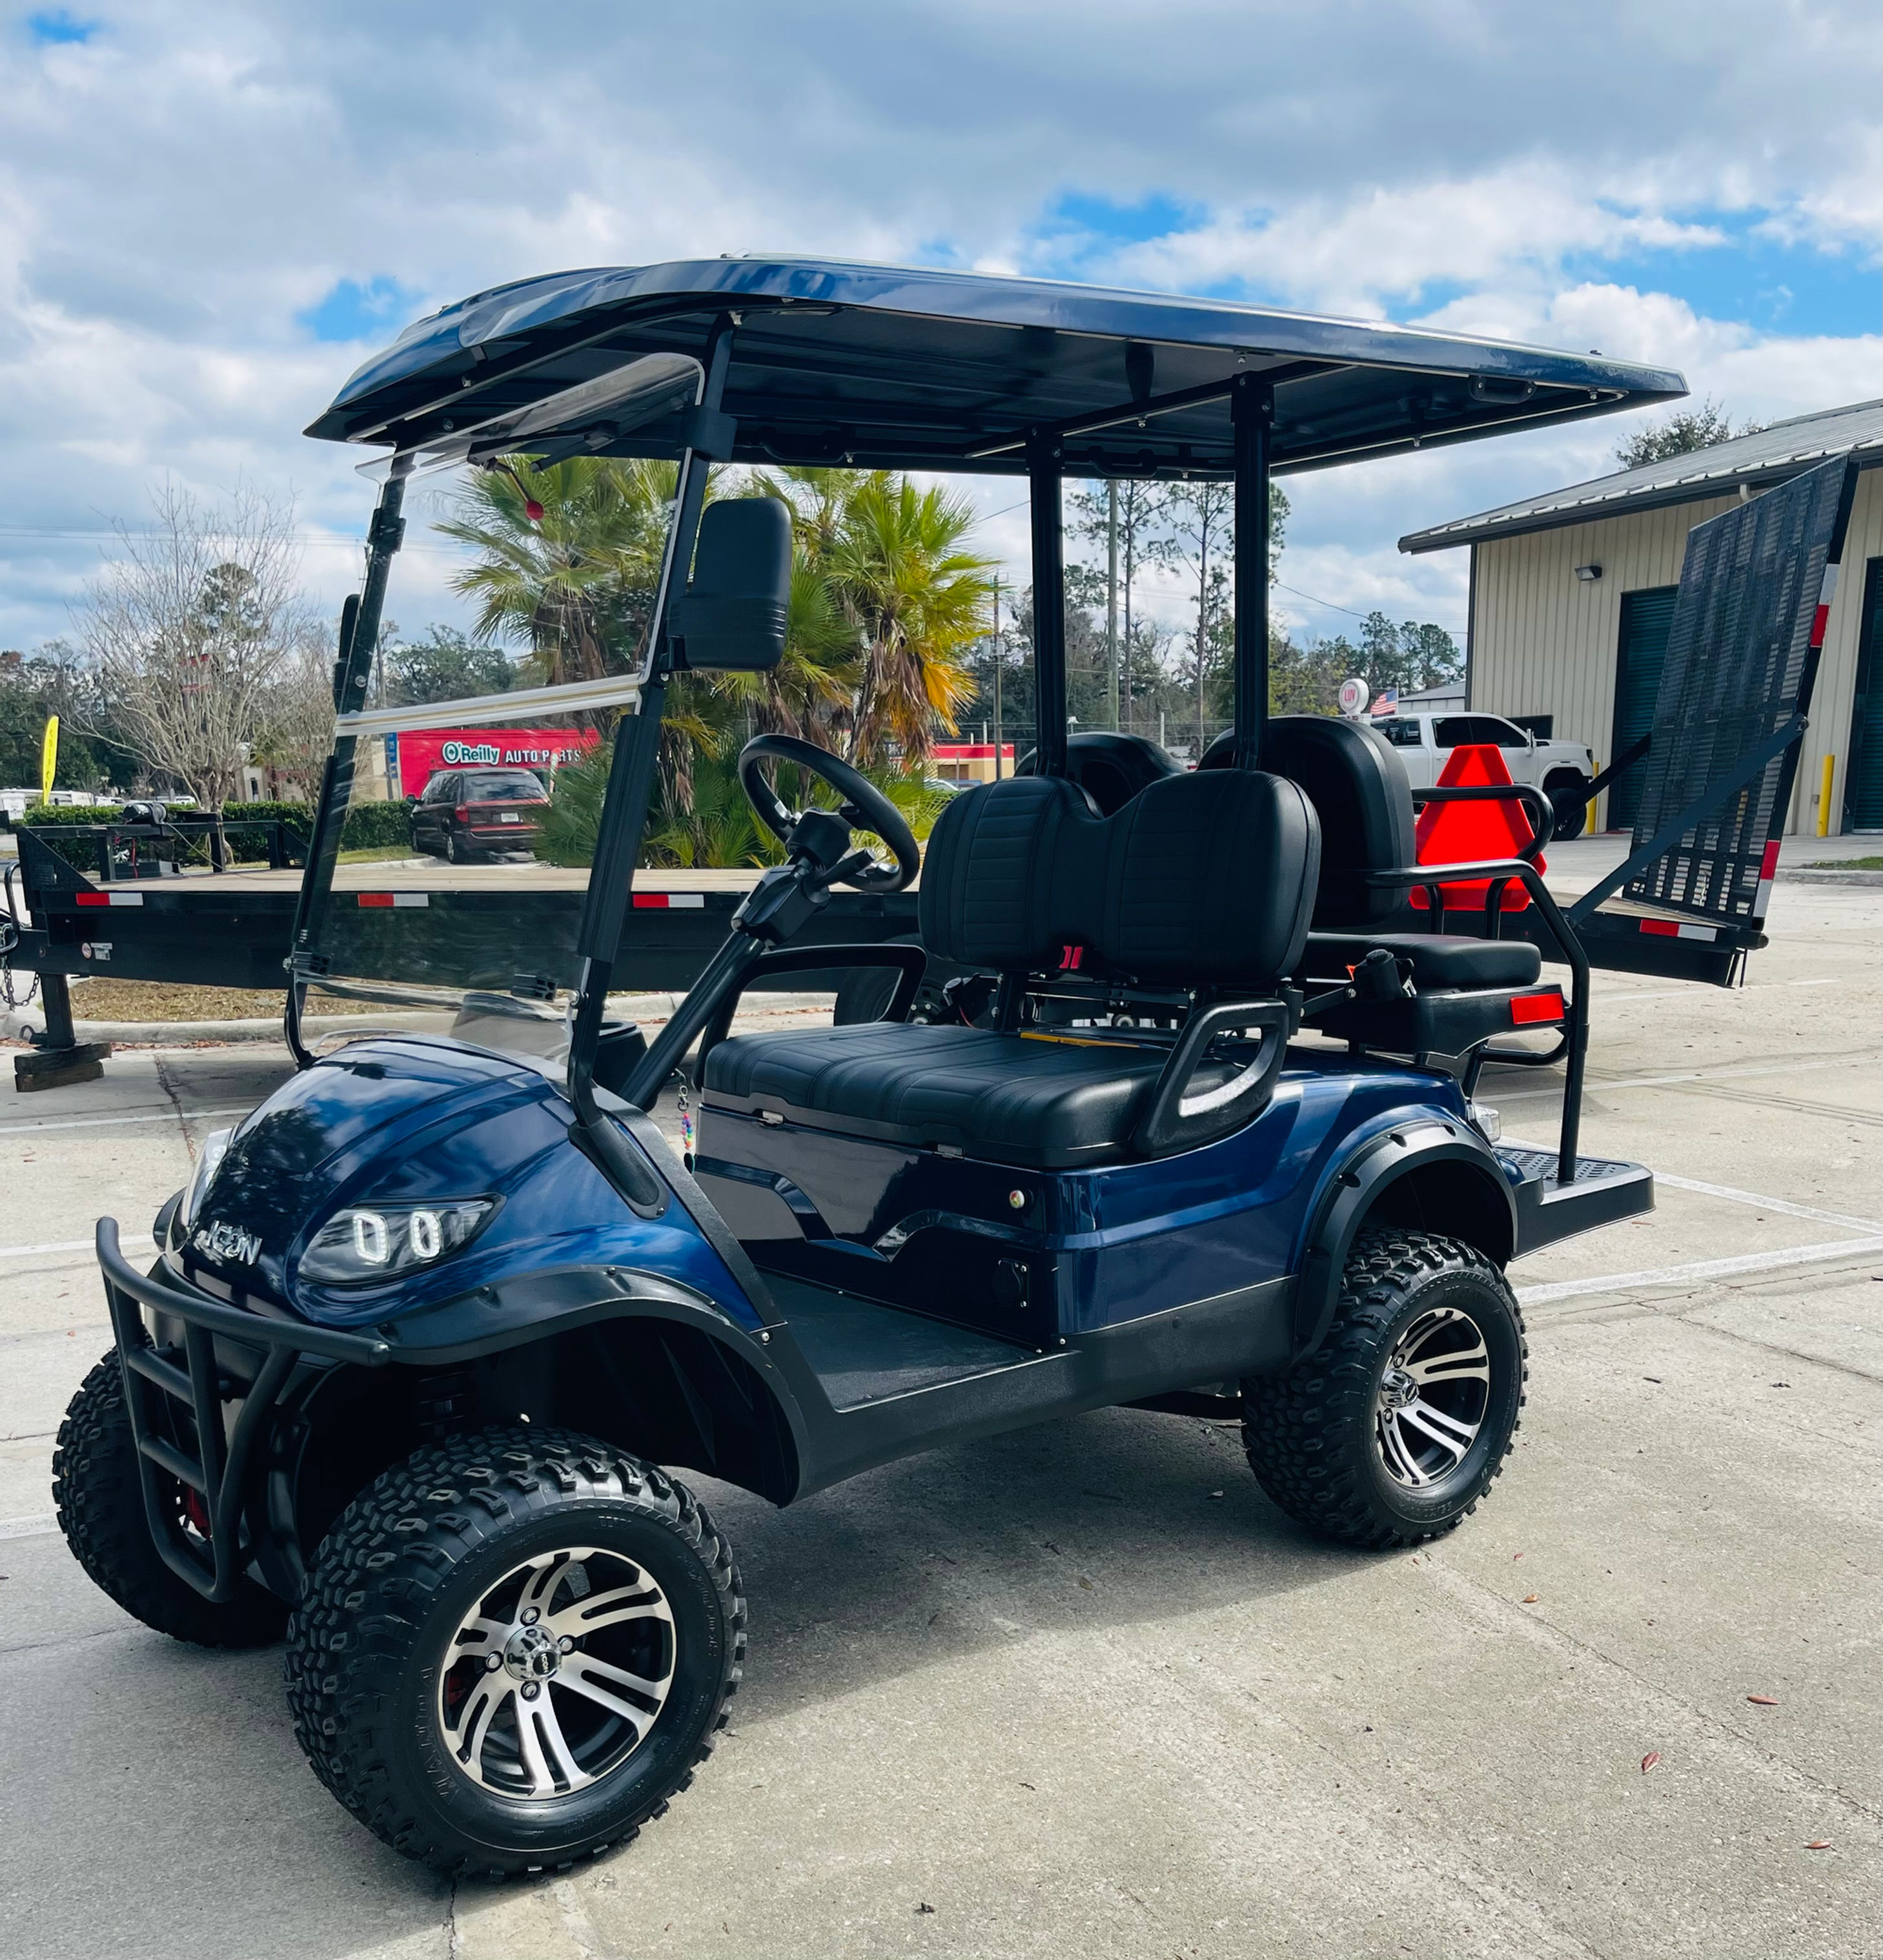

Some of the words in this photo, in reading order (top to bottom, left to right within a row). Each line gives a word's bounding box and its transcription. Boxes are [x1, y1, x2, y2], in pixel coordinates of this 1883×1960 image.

[1344, 688, 1356, 702] LUV
[443, 742, 500, 764] O'Reilly
[505, 750, 538, 762] AUTO
[542, 750, 581, 762] PRTS
